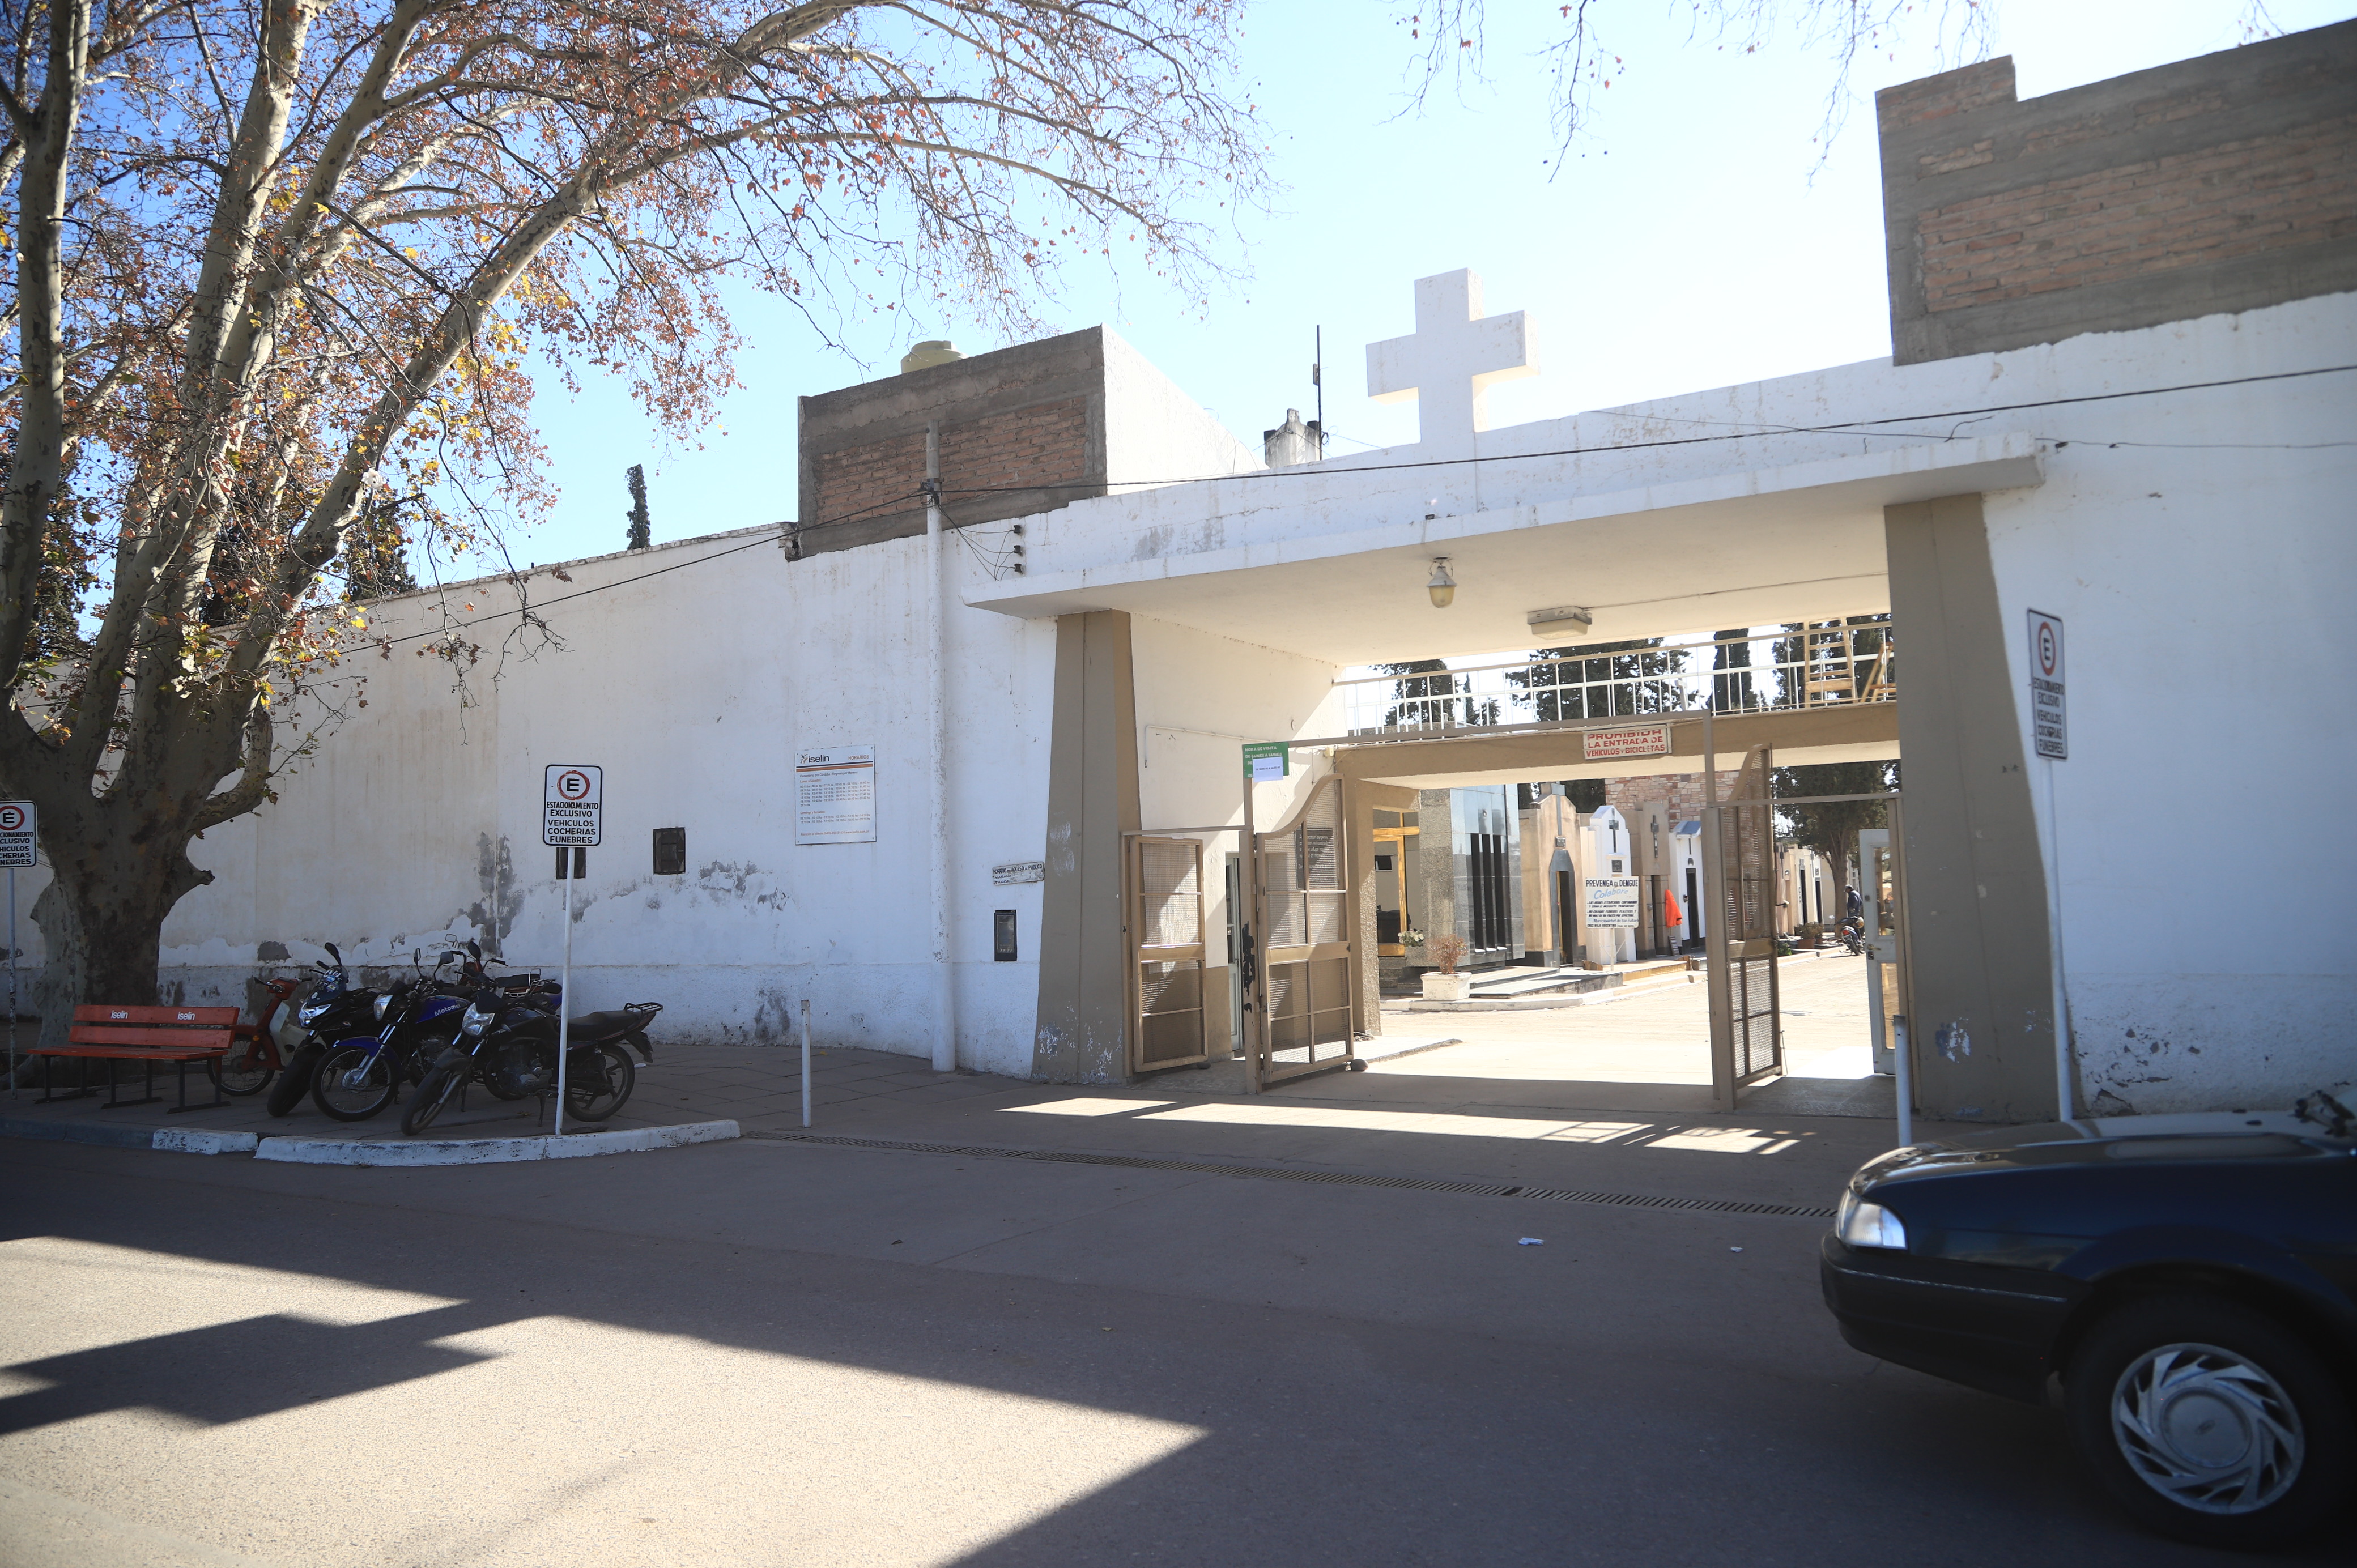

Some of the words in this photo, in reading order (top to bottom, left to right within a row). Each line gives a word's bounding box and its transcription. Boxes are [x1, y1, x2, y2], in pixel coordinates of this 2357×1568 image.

[2043, 637, 2052, 661] E
[2033, 678, 2065, 694] ESTACIONAMIENTO
[2038, 692, 2060, 708] EXCLUSIVO
[2037, 709, 2062, 725] VEHICULOS
[2038, 725, 2062, 739] COCHERIAS
[1603, 737, 1648, 747] ENTRADA
[2039, 738, 2064, 754] FUNEBRES
[809, 755, 829, 763] iselin
[1586, 748, 1620, 757] VEHICULOS
[567, 778, 580, 792] E
[547, 801, 599, 810] ESTACIONAMIENTO
[3, 812, 15, 824] E
[1594, 888, 1628, 900] Colabore
[111, 1010, 128, 1019] iselin
[177, 1011, 195, 1020] iselin
[435, 1003, 461, 1017] Motomel
